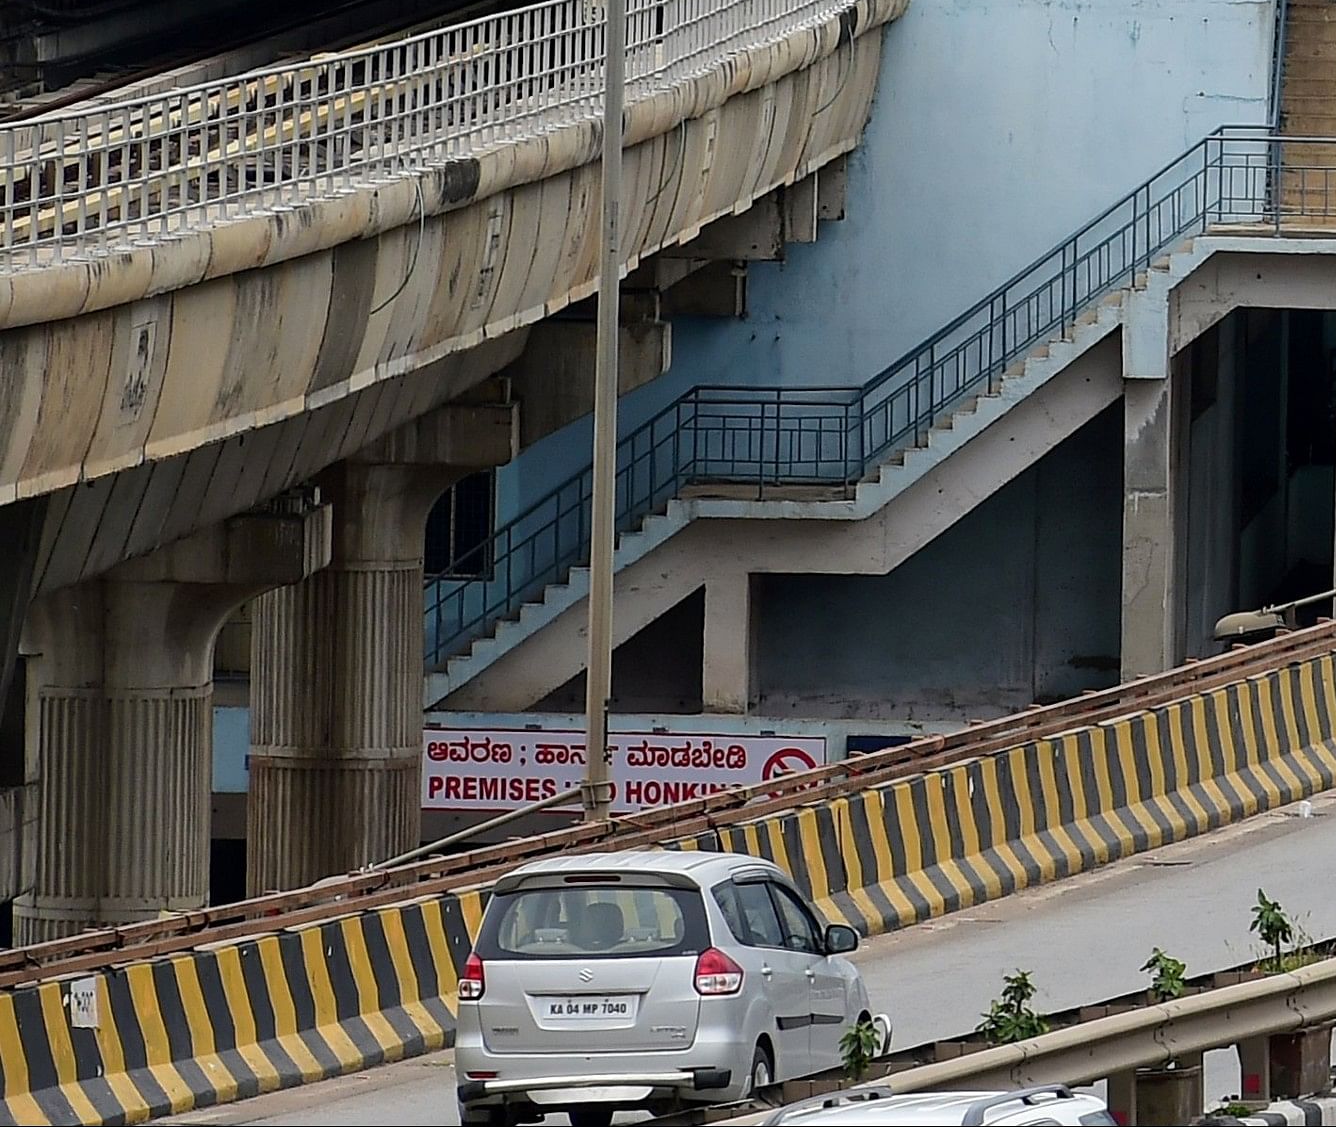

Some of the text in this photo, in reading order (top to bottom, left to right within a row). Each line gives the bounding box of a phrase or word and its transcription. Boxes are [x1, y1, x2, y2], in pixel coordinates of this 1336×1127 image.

[427, 736, 512, 763] ಆವರಣ
[627, 740, 747, 769] ಮಾಡಬೇಡಿ
[428, 776, 557, 801] PREMISES
[550, 1003, 627, 1014] KA 04 MP 7040
